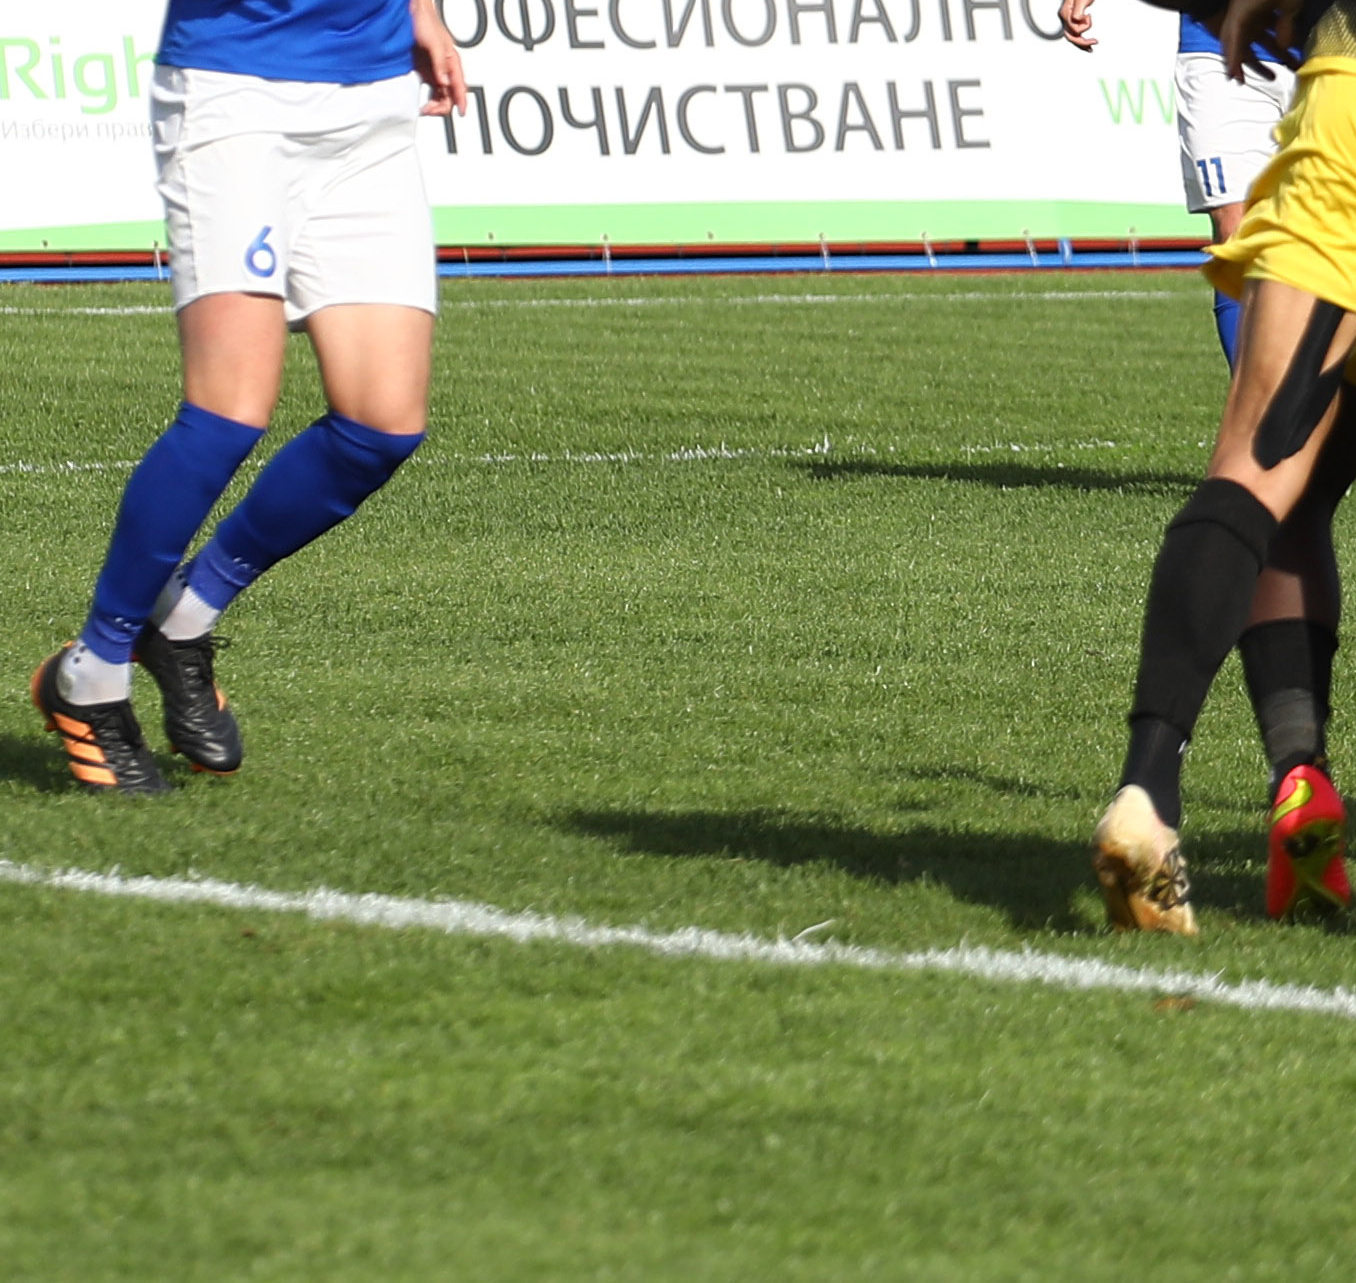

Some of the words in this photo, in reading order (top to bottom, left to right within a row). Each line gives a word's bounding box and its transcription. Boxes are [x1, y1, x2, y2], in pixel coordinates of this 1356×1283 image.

[438, 78, 993, 158] ПОЧИСТВАНЕ
[1196, 156, 1227, 198] 11
[244, 225, 277, 278] 6
